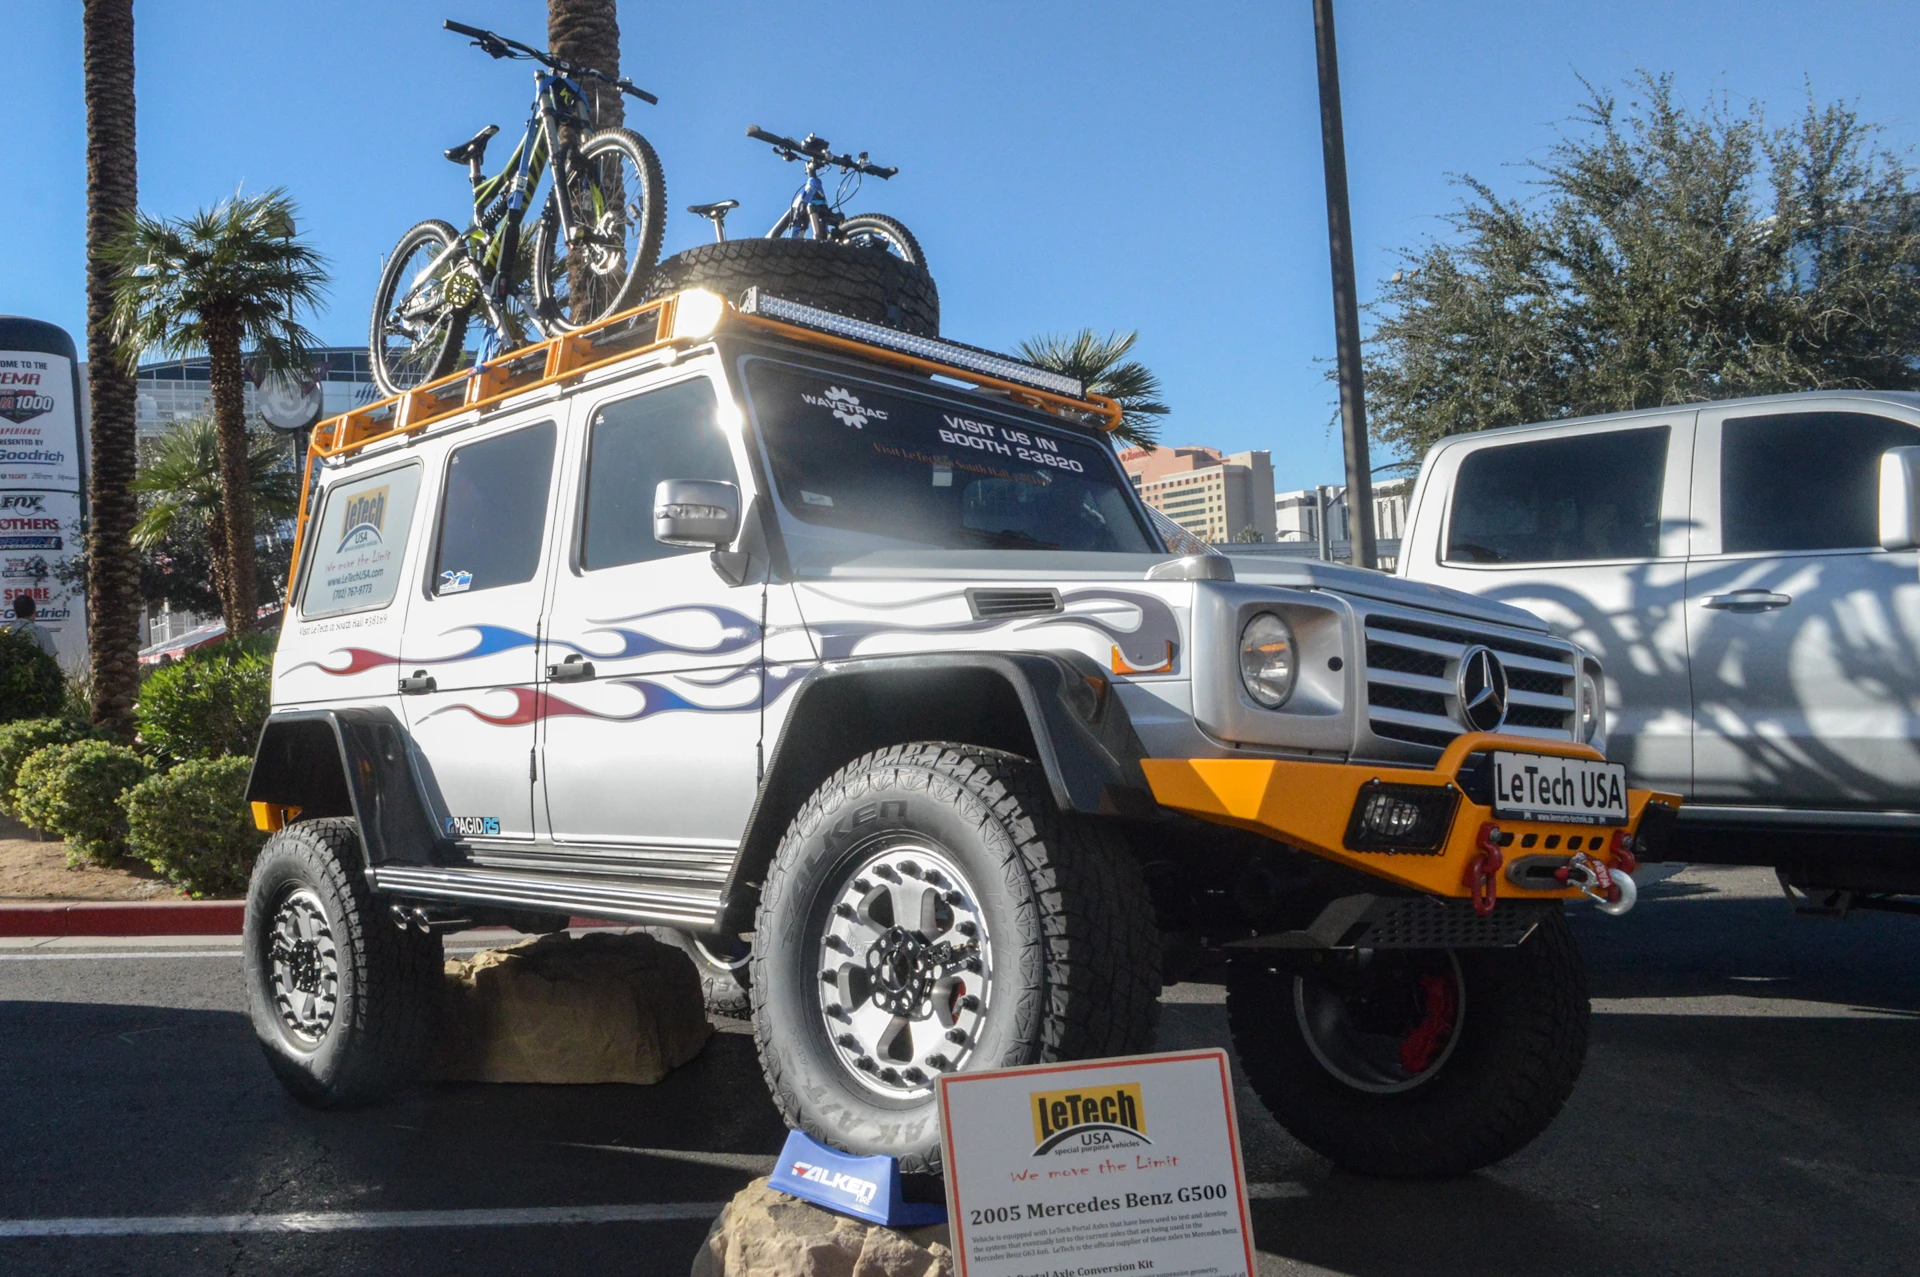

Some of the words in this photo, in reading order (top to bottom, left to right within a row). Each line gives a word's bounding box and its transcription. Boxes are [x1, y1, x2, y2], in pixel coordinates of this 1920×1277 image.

[0, 372, 41, 385] EMA
[20, 361, 32, 369] TO
[34, 361, 48, 370] THE
[16, 395, 53, 410] 1000
[801, 393, 888, 420] WAVETRAC
[943, 414, 995, 437] VISIT
[1001, 428, 1031, 445] US
[1035, 436, 1059, 453] IN
[938, 429, 1012, 456] BOOTH
[1015, 447, 1084, 473] 23820
[342, 492, 384, 539] LeTech
[355, 532, 368, 544] USA
[325, 562, 336, 573] We
[357, 553, 369, 567] the
[327, 568, 384, 587] www.LeTechUSA.com
[332, 587, 348, 601] (702)
[1497, 763, 1575, 806] LeTech
[1581, 770, 1623, 810] USA
[1592, 860, 1610, 888] WARN
[1038, 1090, 1138, 1141] LeTech
[1055, 1144, 1079, 1155] special
[1081, 1144, 1110, 1154] purpose
[1111, 1140, 1140, 1149] vehicles
[1081, 1132, 1112, 1146] USA
[790, 1161, 877, 1200] FALKEN
[1010, 1169, 1039, 1182] We
[1049, 1167, 1089, 1179] move
[1099, 1160, 1127, 1174] the
[1136, 1155, 1180, 1170] Limit
[855, 1193, 871, 1206] TIRE
[971, 1205, 1021, 1225] 2005
[1026, 1197, 1120, 1219] Mercedes
[1125, 1192, 1173, 1209] Benz
[1178, 1184, 1227, 1203] G500
[972, 1235, 996, 1244] Vehicle
[1003, 1230, 1032, 1241] equipped
[1033, 1228, 1048, 1237] with
[1049, 1226, 1071, 1235] LeTech
[1072, 1224, 1091, 1232] Portal
[1092, 1222, 1109, 1230] Axles
[1124, 1219, 1138, 1227] have
[1139, 1217, 1154, 1225] been
[1155, 1215, 1170, 1223] used
[1191, 1211, 1202, 1219] and
[1203, 1210, 1228, 1218] develop
[985, 1244, 1007, 1252] system
[1022, 1236, 1054, 1247] eventually
[1085, 1232, 1109, 1240] current
[1110, 1230, 1125, 1238] axles
[1126, 1228, 1139, 1236] that
[1151, 1225, 1168, 1234] being
[1169, 1223, 1185, 1231] used
[974, 1254, 1005, 1263] Mercedes
[1022, 1249, 1036, 1257] G63
[1053, 1244, 1075, 1254] LeTech
[1082, 1242, 1093, 1250] the
[1094, 1239, 1115, 1249] official
[1116, 1238, 1141, 1247] supplier
[1150, 1234, 1167, 1242] these
[1168, 1232, 1183, 1240] axles
[1192, 1228, 1221, 1238] Mercedes
[1222, 1227, 1239, 1235] Benz.
[1052, 1269, 1072, 1277] Axle
[1077, 1263, 1136, 1276] Conversion
[1138, 1260, 1154, 1269] Kit
[1190, 1267, 1219, 1276] geometry.
